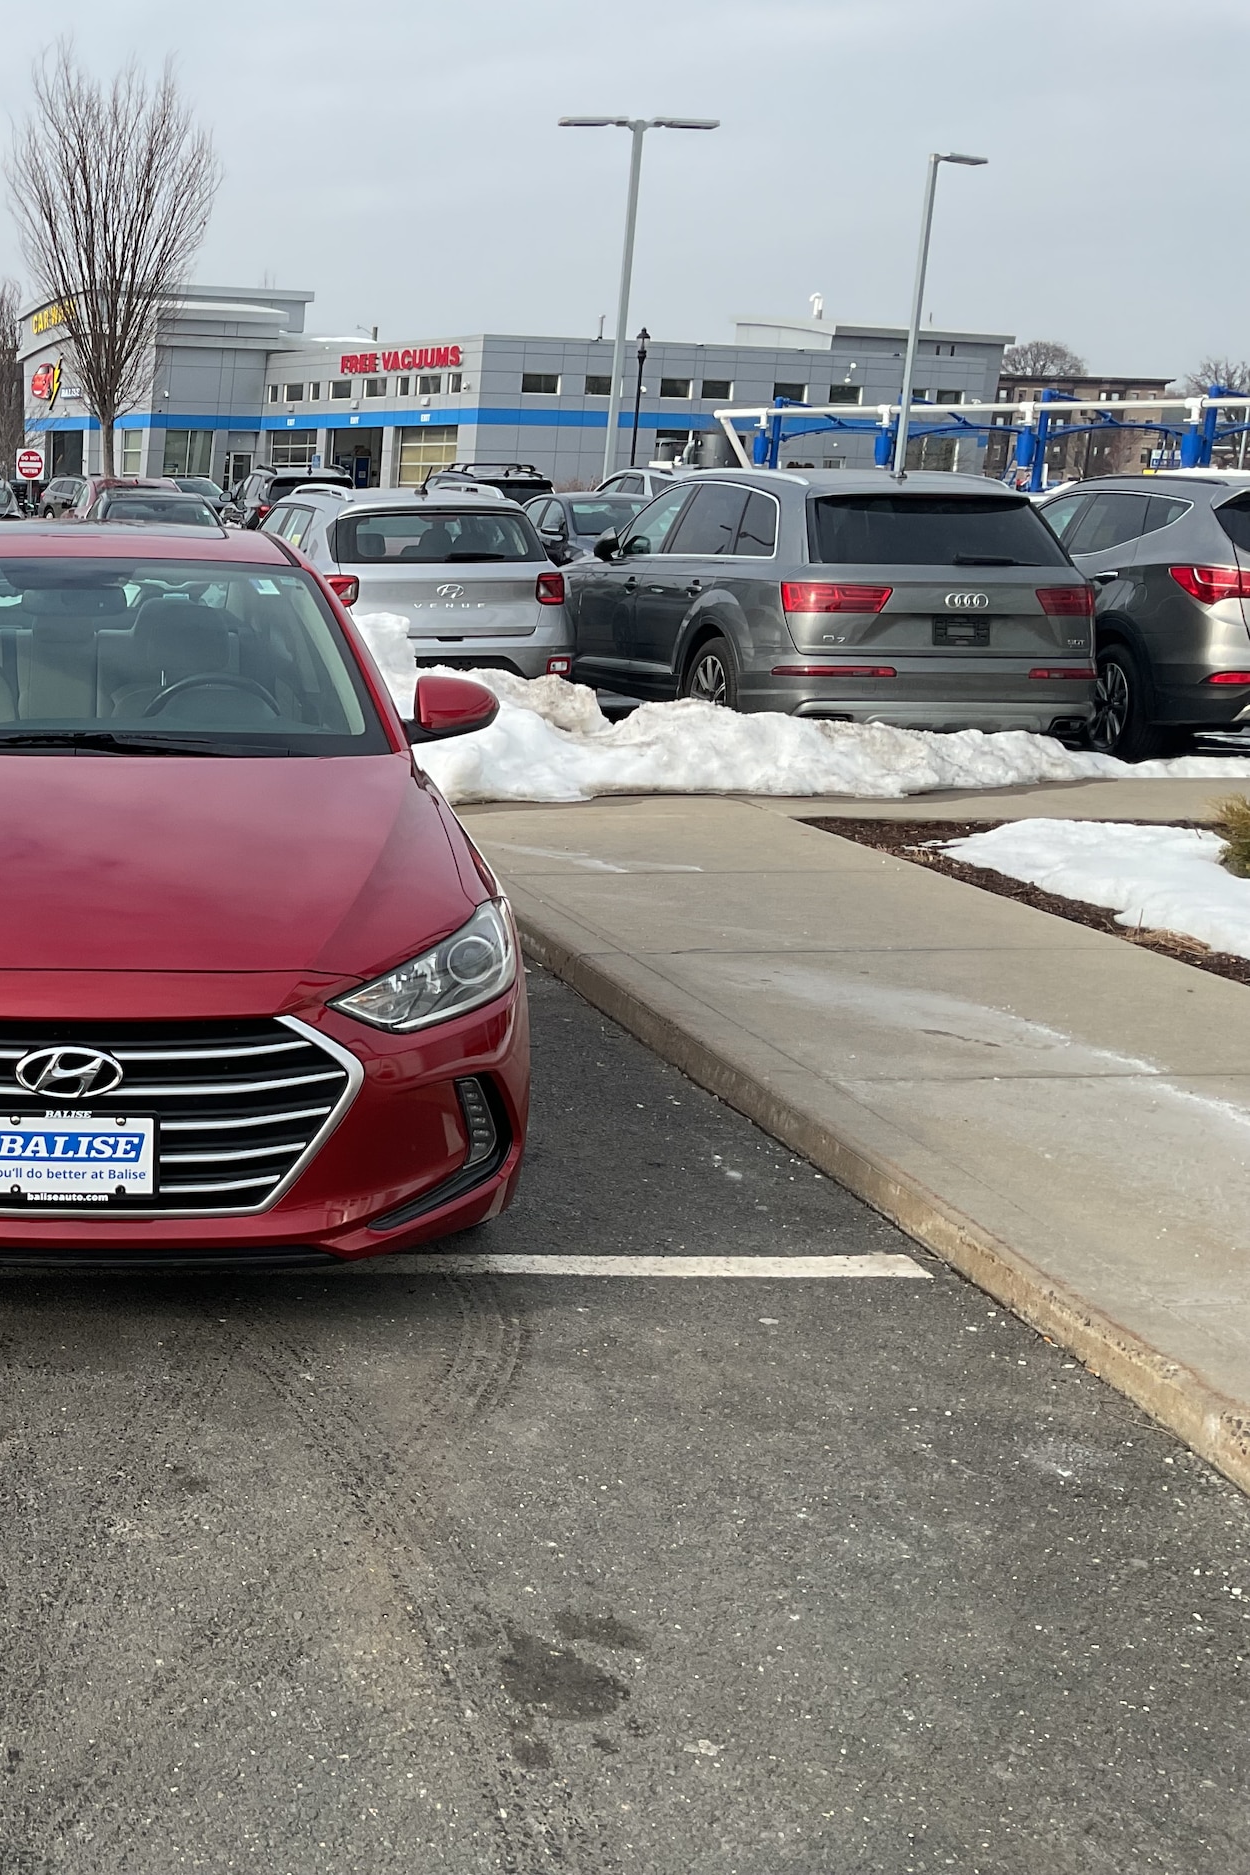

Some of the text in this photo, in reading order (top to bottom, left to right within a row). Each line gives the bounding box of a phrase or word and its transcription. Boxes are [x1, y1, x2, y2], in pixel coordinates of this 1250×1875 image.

[32, 310, 48, 334] CAR
[340, 345, 462, 374] FREE VACUUMS
[44, 1110, 92, 1118] BALISE
[26, 1168, 43, 1178] do
[46, 1168, 87, 1179] better
[91, 1170, 104, 1179] at
[108, 1169, 146, 1180] Balise
[27, 1193, 109, 1202] baliseauto.com
